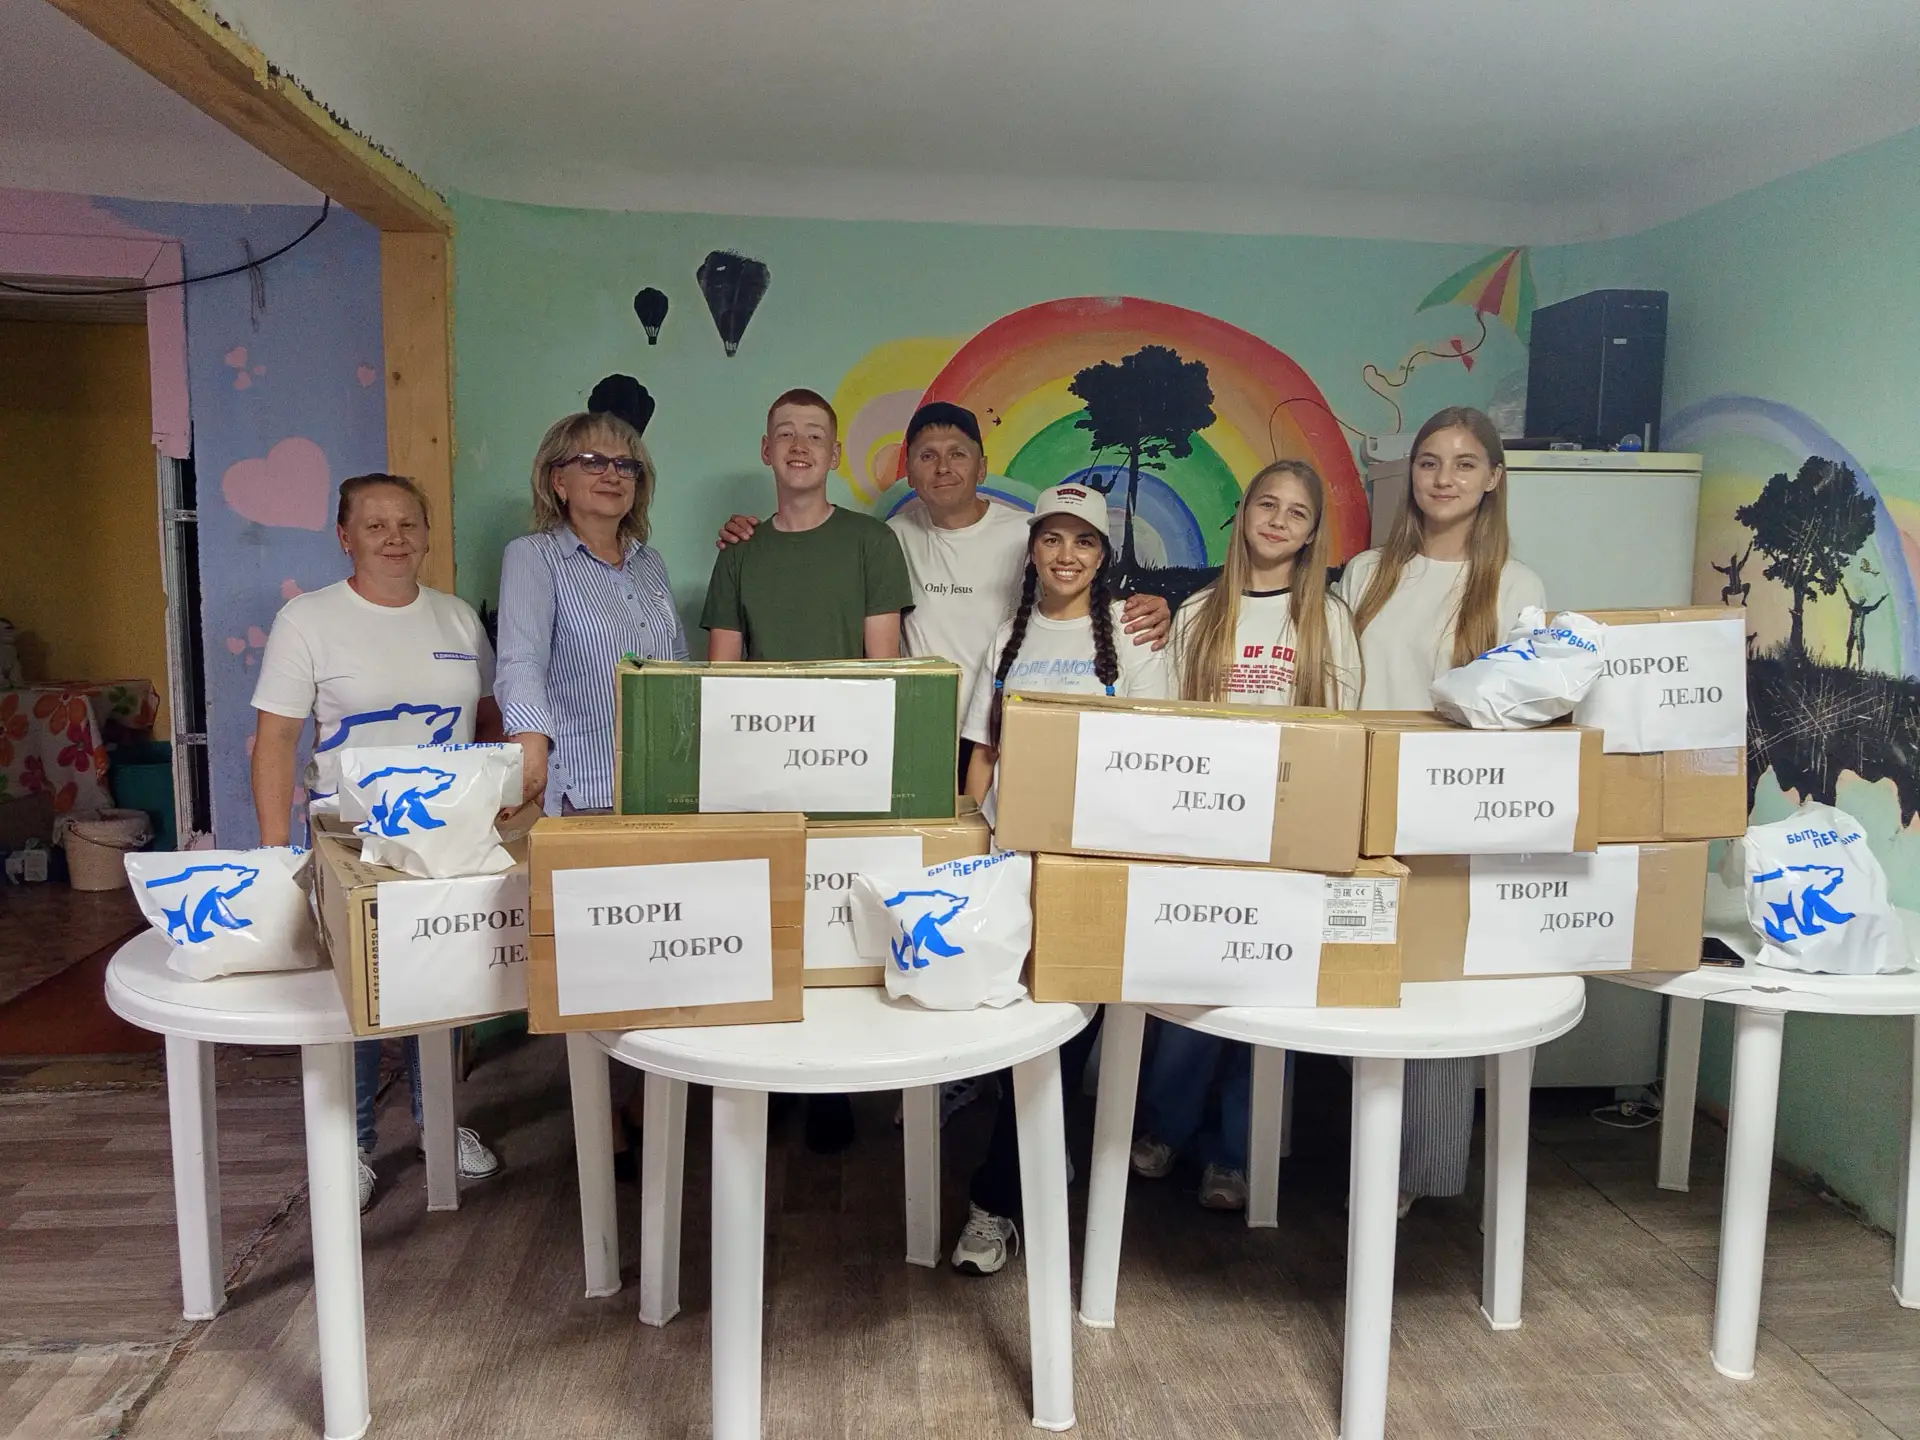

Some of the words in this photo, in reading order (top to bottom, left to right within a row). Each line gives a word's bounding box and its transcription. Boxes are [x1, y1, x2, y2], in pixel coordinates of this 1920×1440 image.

[925, 583, 948, 596] Only
[951, 584, 973, 594] Jesus
[1243, 645, 1264, 658] OF
[1271, 645, 1296, 663] GO
[1598, 655, 1689, 677] ДОБРОЕ
[1659, 686, 1723, 708] ДЕЛО
[731, 714, 816, 732] ТВОРИ
[783, 748, 869, 769] ДОБРО
[1105, 750, 1211, 775] ДОБРОЕ
[1426, 767, 1506, 786] ТВОРИ
[1172, 790, 1246, 812] ДЕЛО
[1474, 800, 1555, 822] ДОБРО
[1786, 829, 1819, 845] БЫТЬ
[927, 861, 962, 877] БЫТЬ
[953, 851, 1016, 877] ПЕРВЫМ
[1496, 881, 1570, 901] ТВОРИ
[411, 908, 525, 941] ДОБРОЕ
[587, 902, 683, 926] ТВОРИ
[1155, 903, 1259, 925] ДОБРОЕ
[1540, 911, 1614, 933] ДОБРО
[649, 934, 744, 964] ДОБРО
[1221, 941, 1294, 961] ДЕЛО
